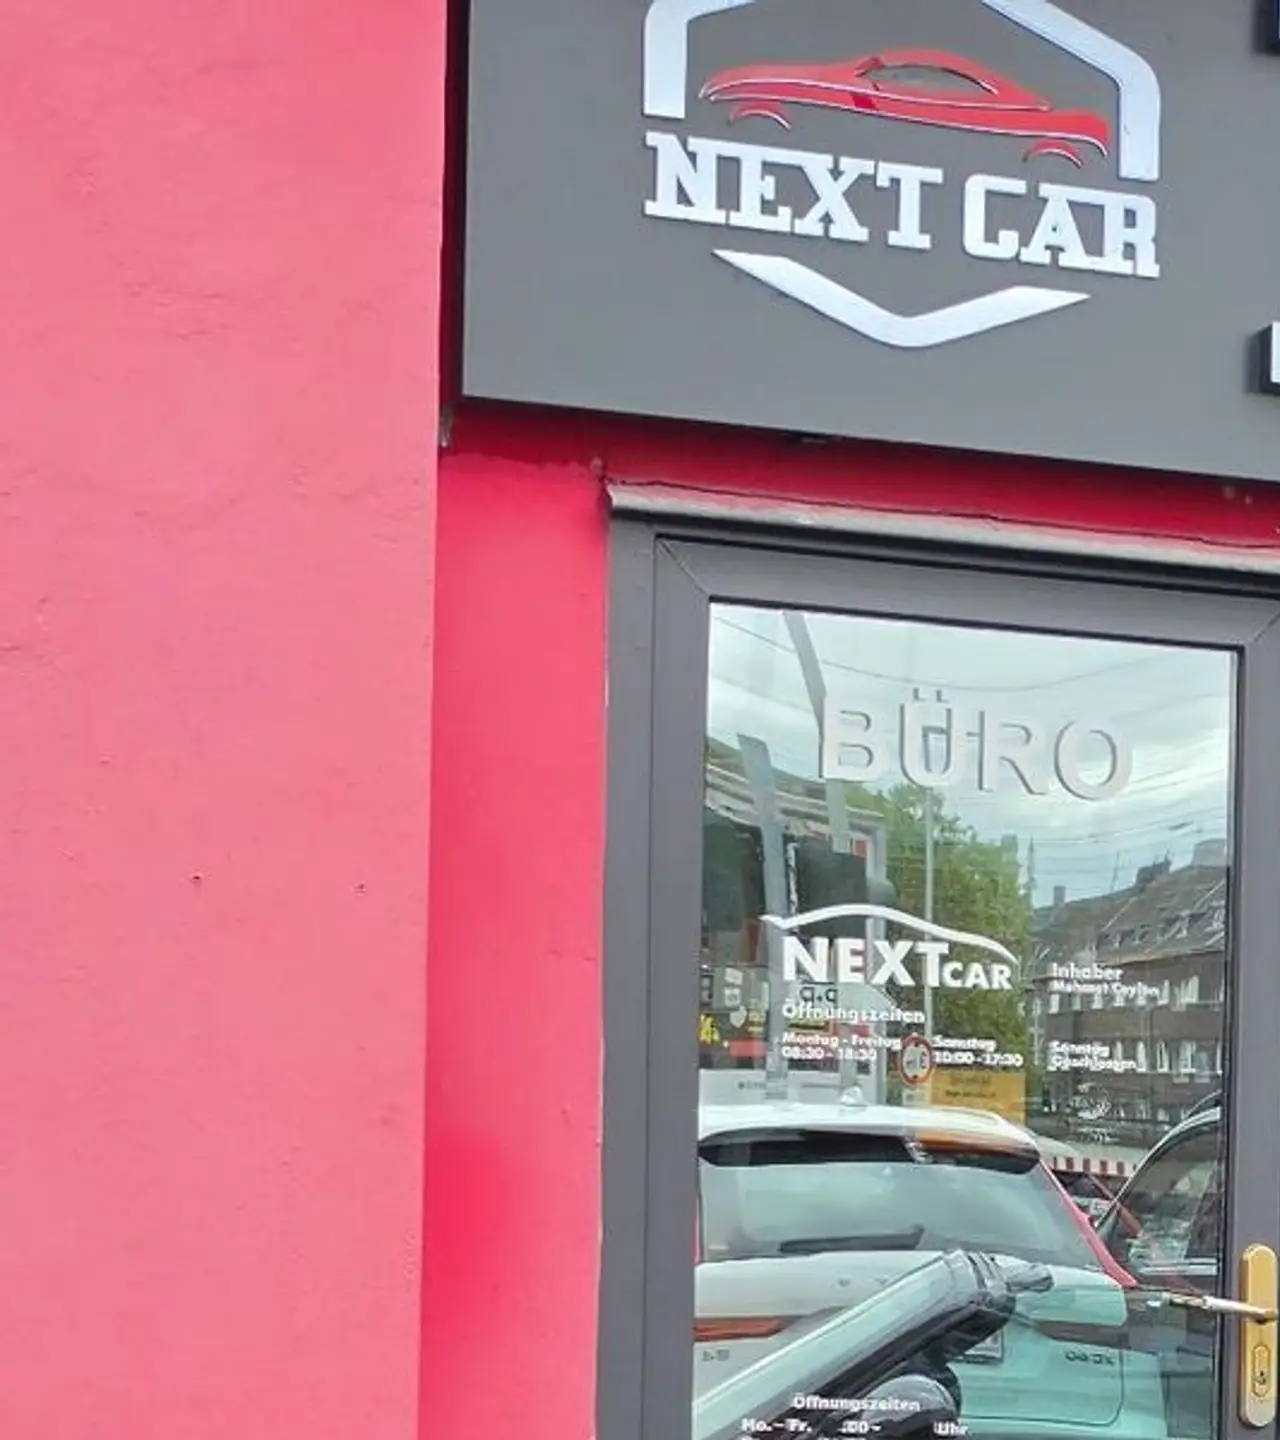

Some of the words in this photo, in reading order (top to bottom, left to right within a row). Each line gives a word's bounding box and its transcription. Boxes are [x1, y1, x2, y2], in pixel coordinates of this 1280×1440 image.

[642, 131, 944, 252] NEXT
[962, 172, 1161, 279] CAR
[819, 687, 1133, 801] BÜRO
[1052, 961, 1124, 979] Inhaber
[781, 998, 926, 1023] Öffnungszeiten
[782, 1031, 840, 1048] Montag
[851, 1033, 902, 1051] Freitag
[932, 1034, 997, 1053] Samstag
[793, 1393, 921, 1413] Öffnungszeiten
[933, 1420, 969, 1436] Uhr
